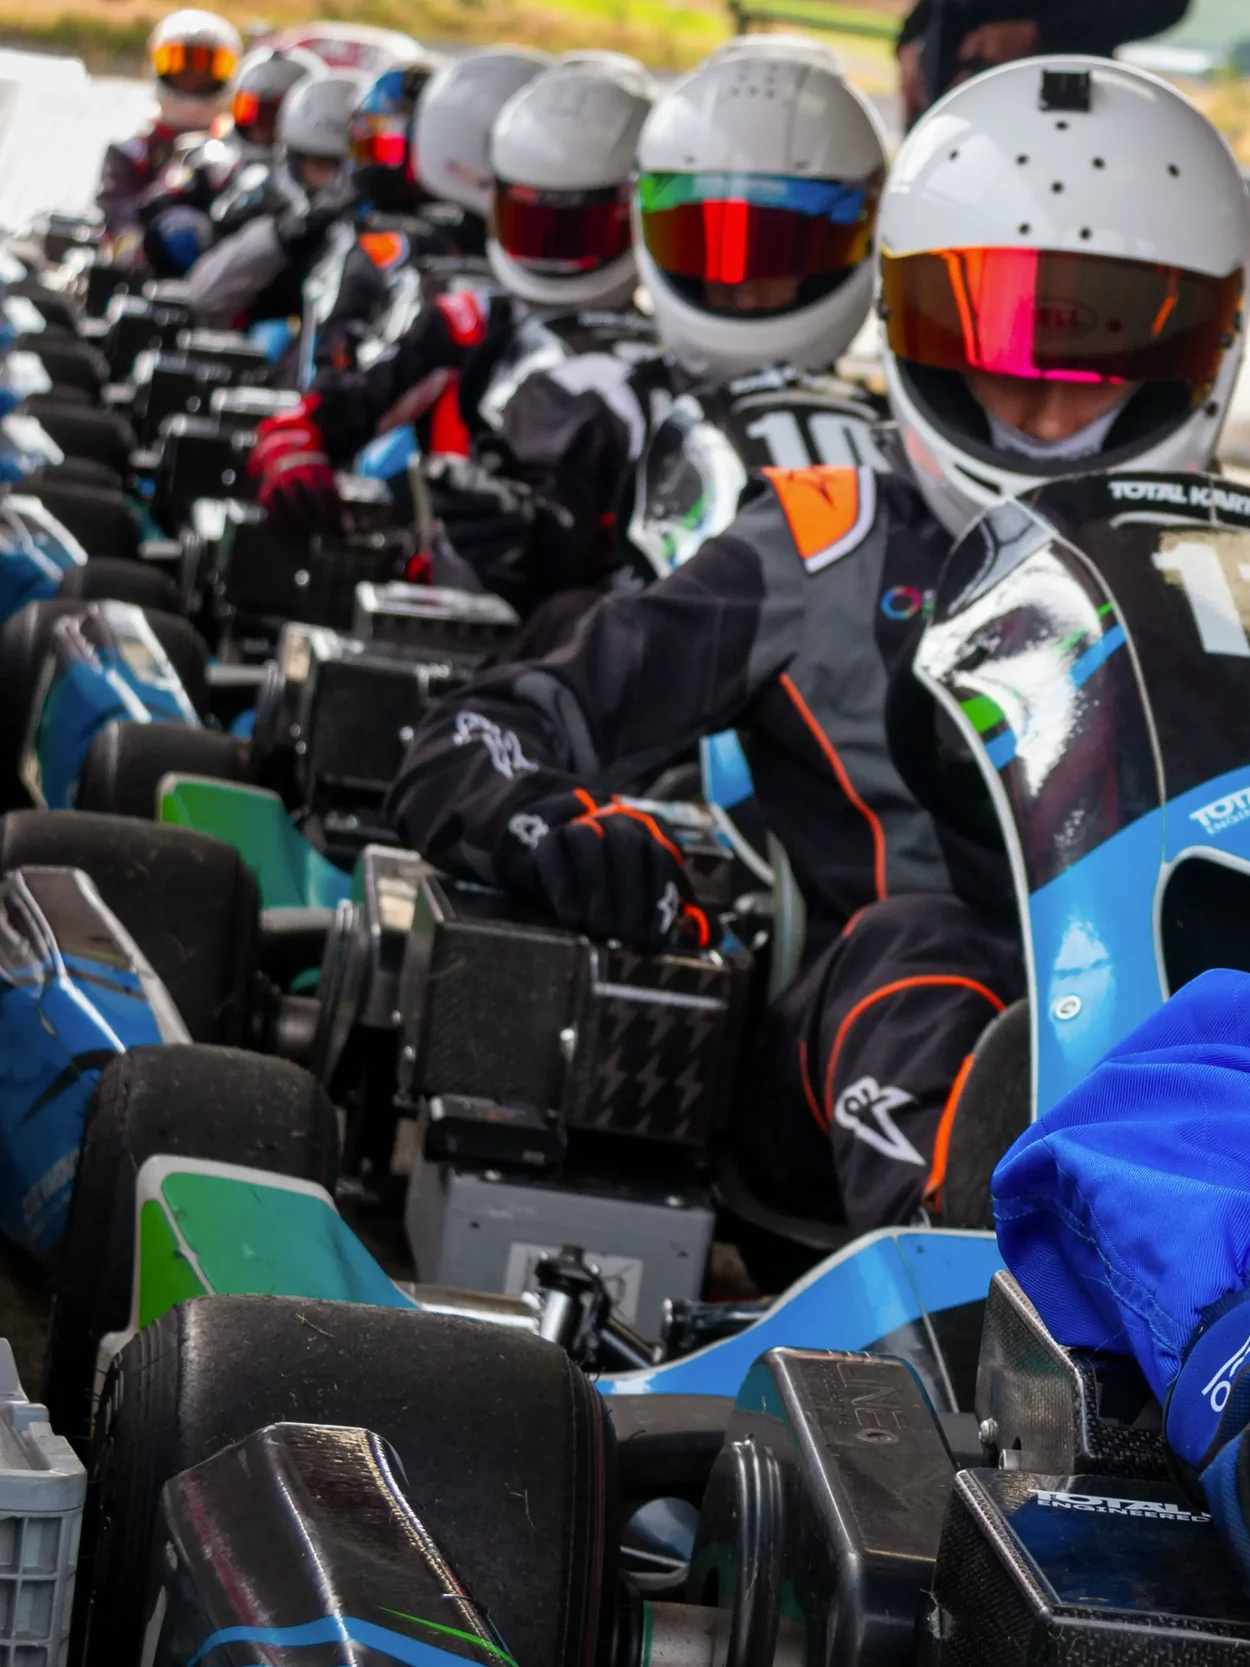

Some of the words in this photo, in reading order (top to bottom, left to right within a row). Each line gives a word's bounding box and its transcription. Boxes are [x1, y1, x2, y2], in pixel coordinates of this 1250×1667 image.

[1107, 480, 1187, 504] TOTAL
[1028, 1489, 1192, 1516] TOTAL
[1037, 1500, 1212, 1522] ENGINEERED
